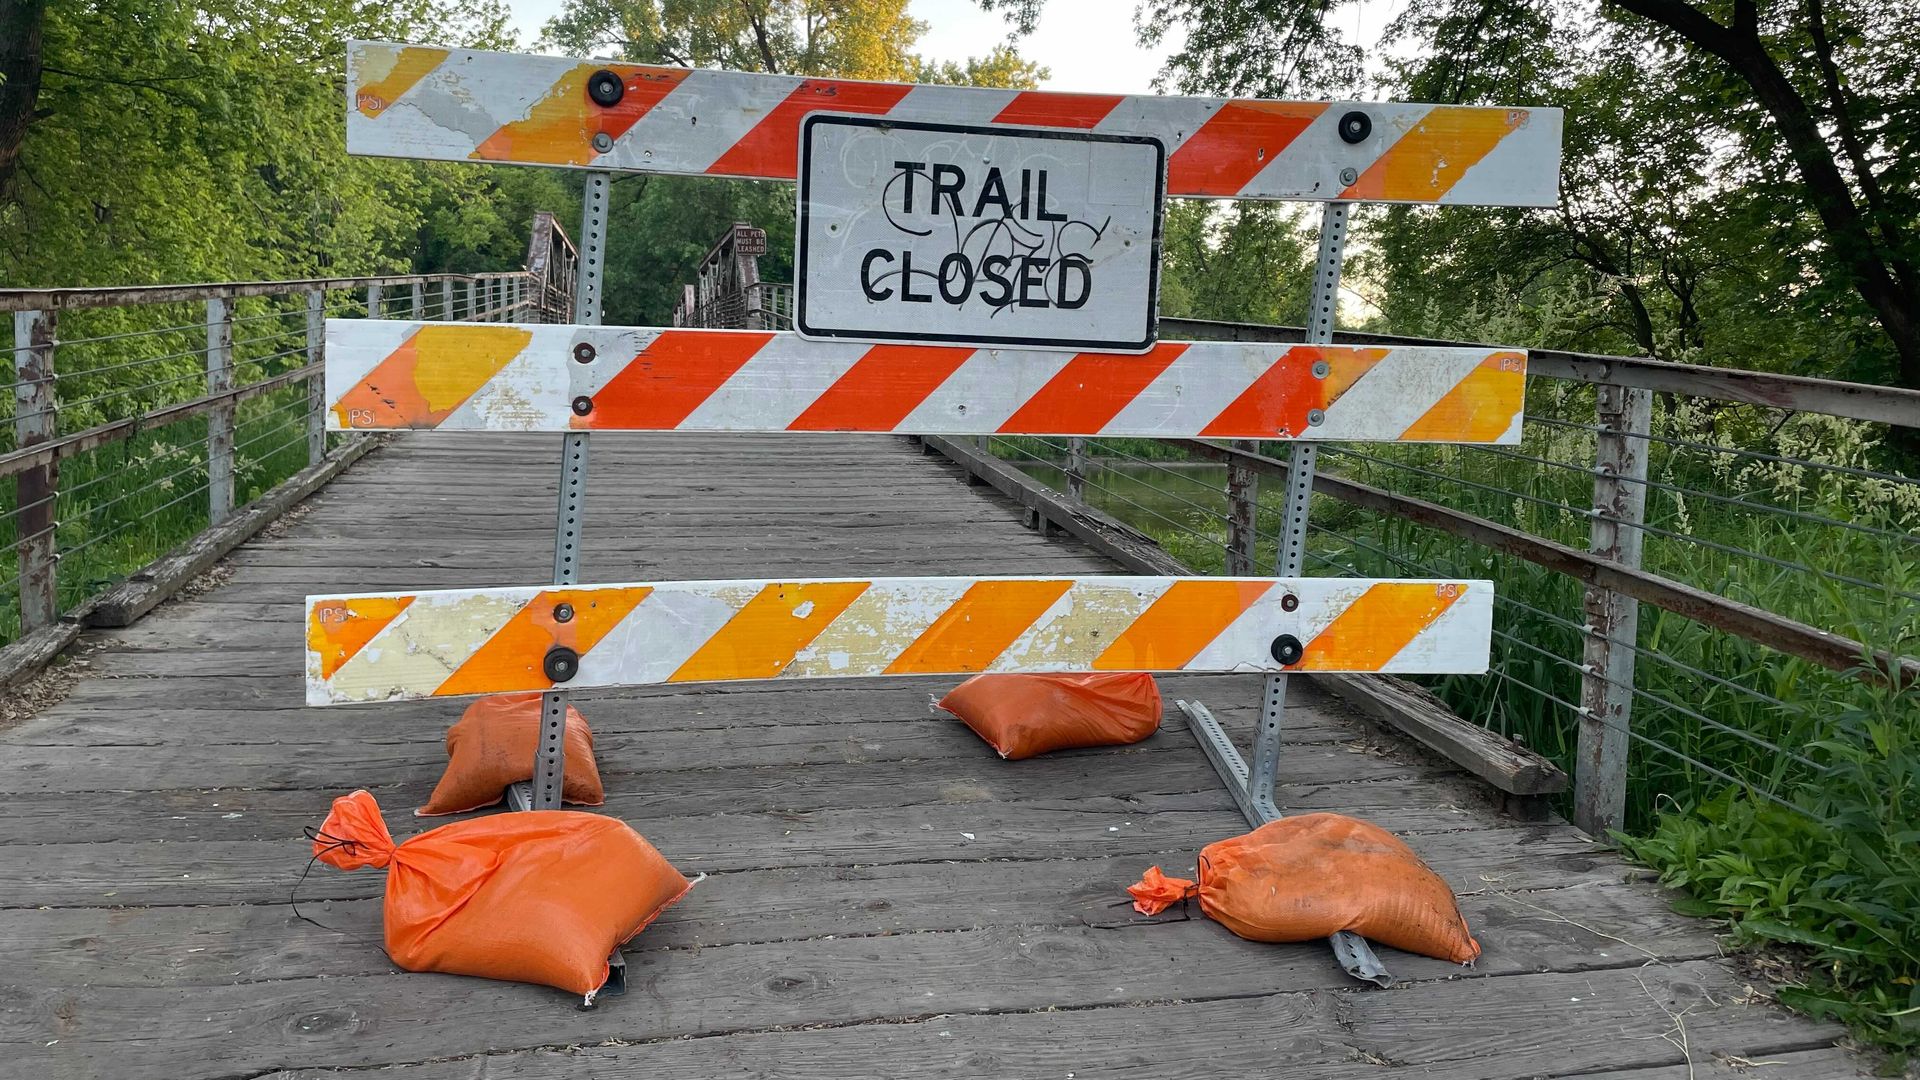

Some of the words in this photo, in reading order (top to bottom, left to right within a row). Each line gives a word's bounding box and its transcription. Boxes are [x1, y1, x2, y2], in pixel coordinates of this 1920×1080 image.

[894, 161, 1068, 223] TRAIL
[737, 230, 747, 238] ALL
[750, 230, 765, 238] PETS
[737, 245, 765, 253] LEASHED
[860, 248, 1092, 309] CLOSED
